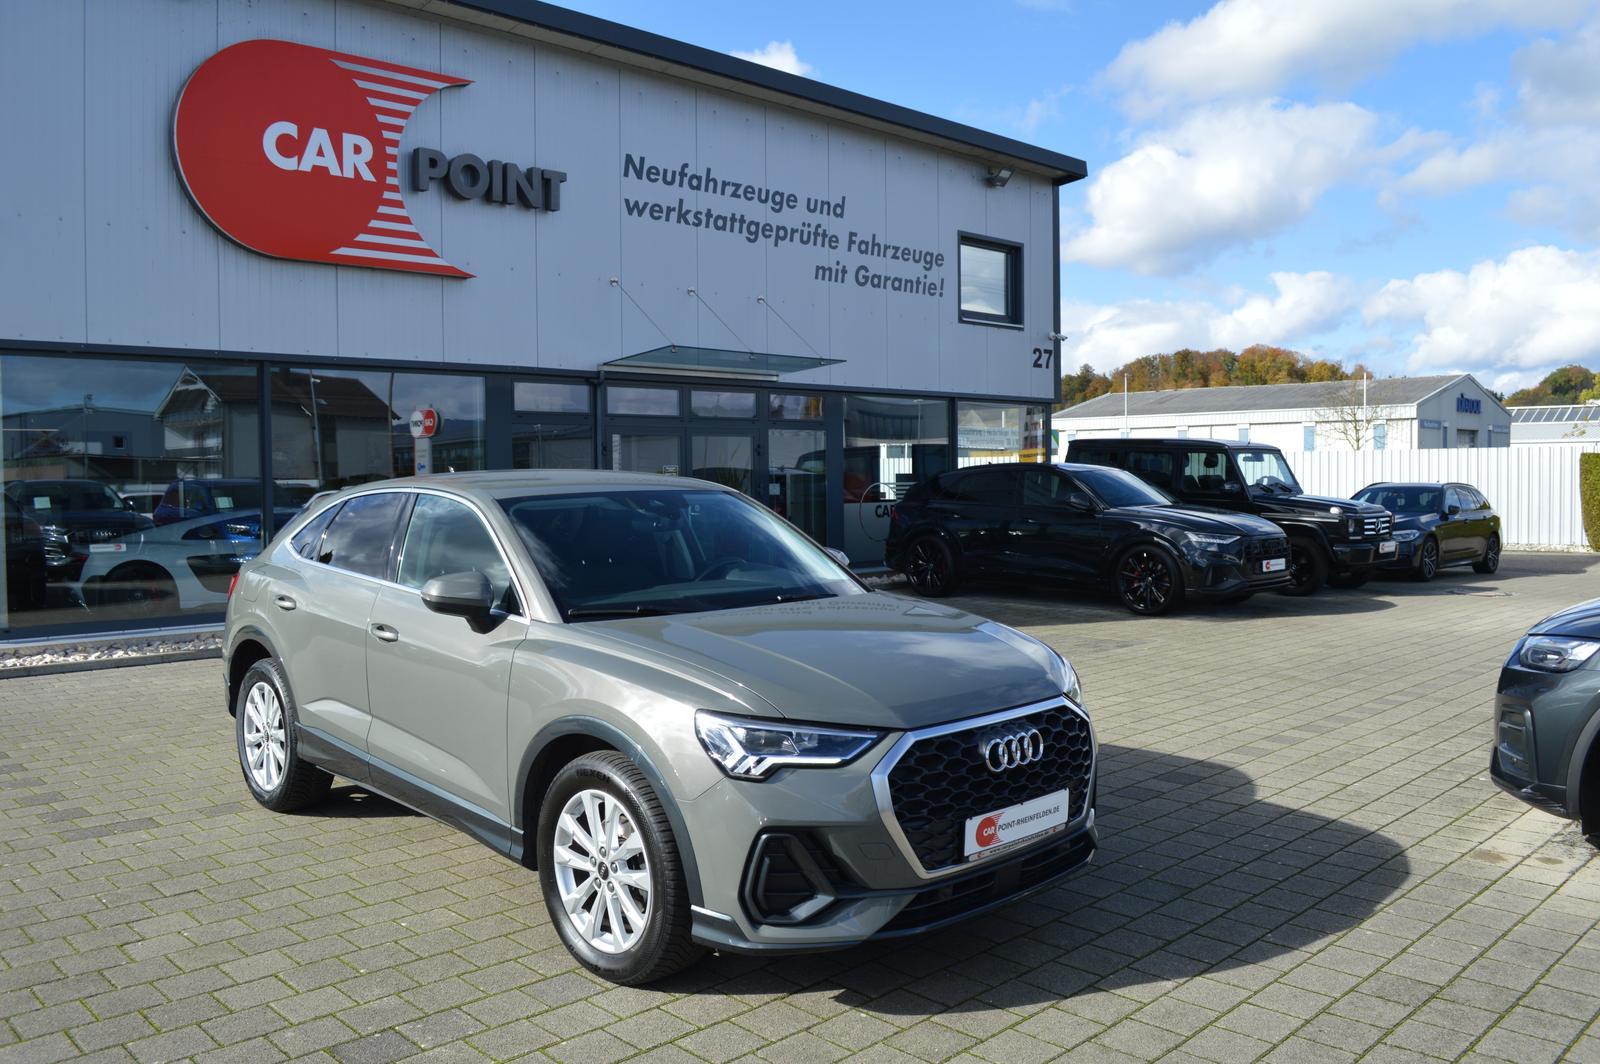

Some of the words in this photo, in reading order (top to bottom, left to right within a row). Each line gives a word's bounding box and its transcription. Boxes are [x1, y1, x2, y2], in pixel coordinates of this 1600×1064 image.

[262, 121, 376, 182] CAR
[412, 147, 567, 211] POINT
[623, 153, 798, 213] Neufahrzeuge
[806, 196, 846, 219] und
[624, 197, 839, 251] werkstattgeprüfte
[846, 231, 945, 272] Fahrzeuge
[814, 260, 848, 284] mit
[854, 265, 945, 298] Garantie!
[1032, 347, 1053, 369] 27
[982, 825, 996, 836] CAR
[997, 805, 1060, 832] POINT-RHEINFELDEN.DE
